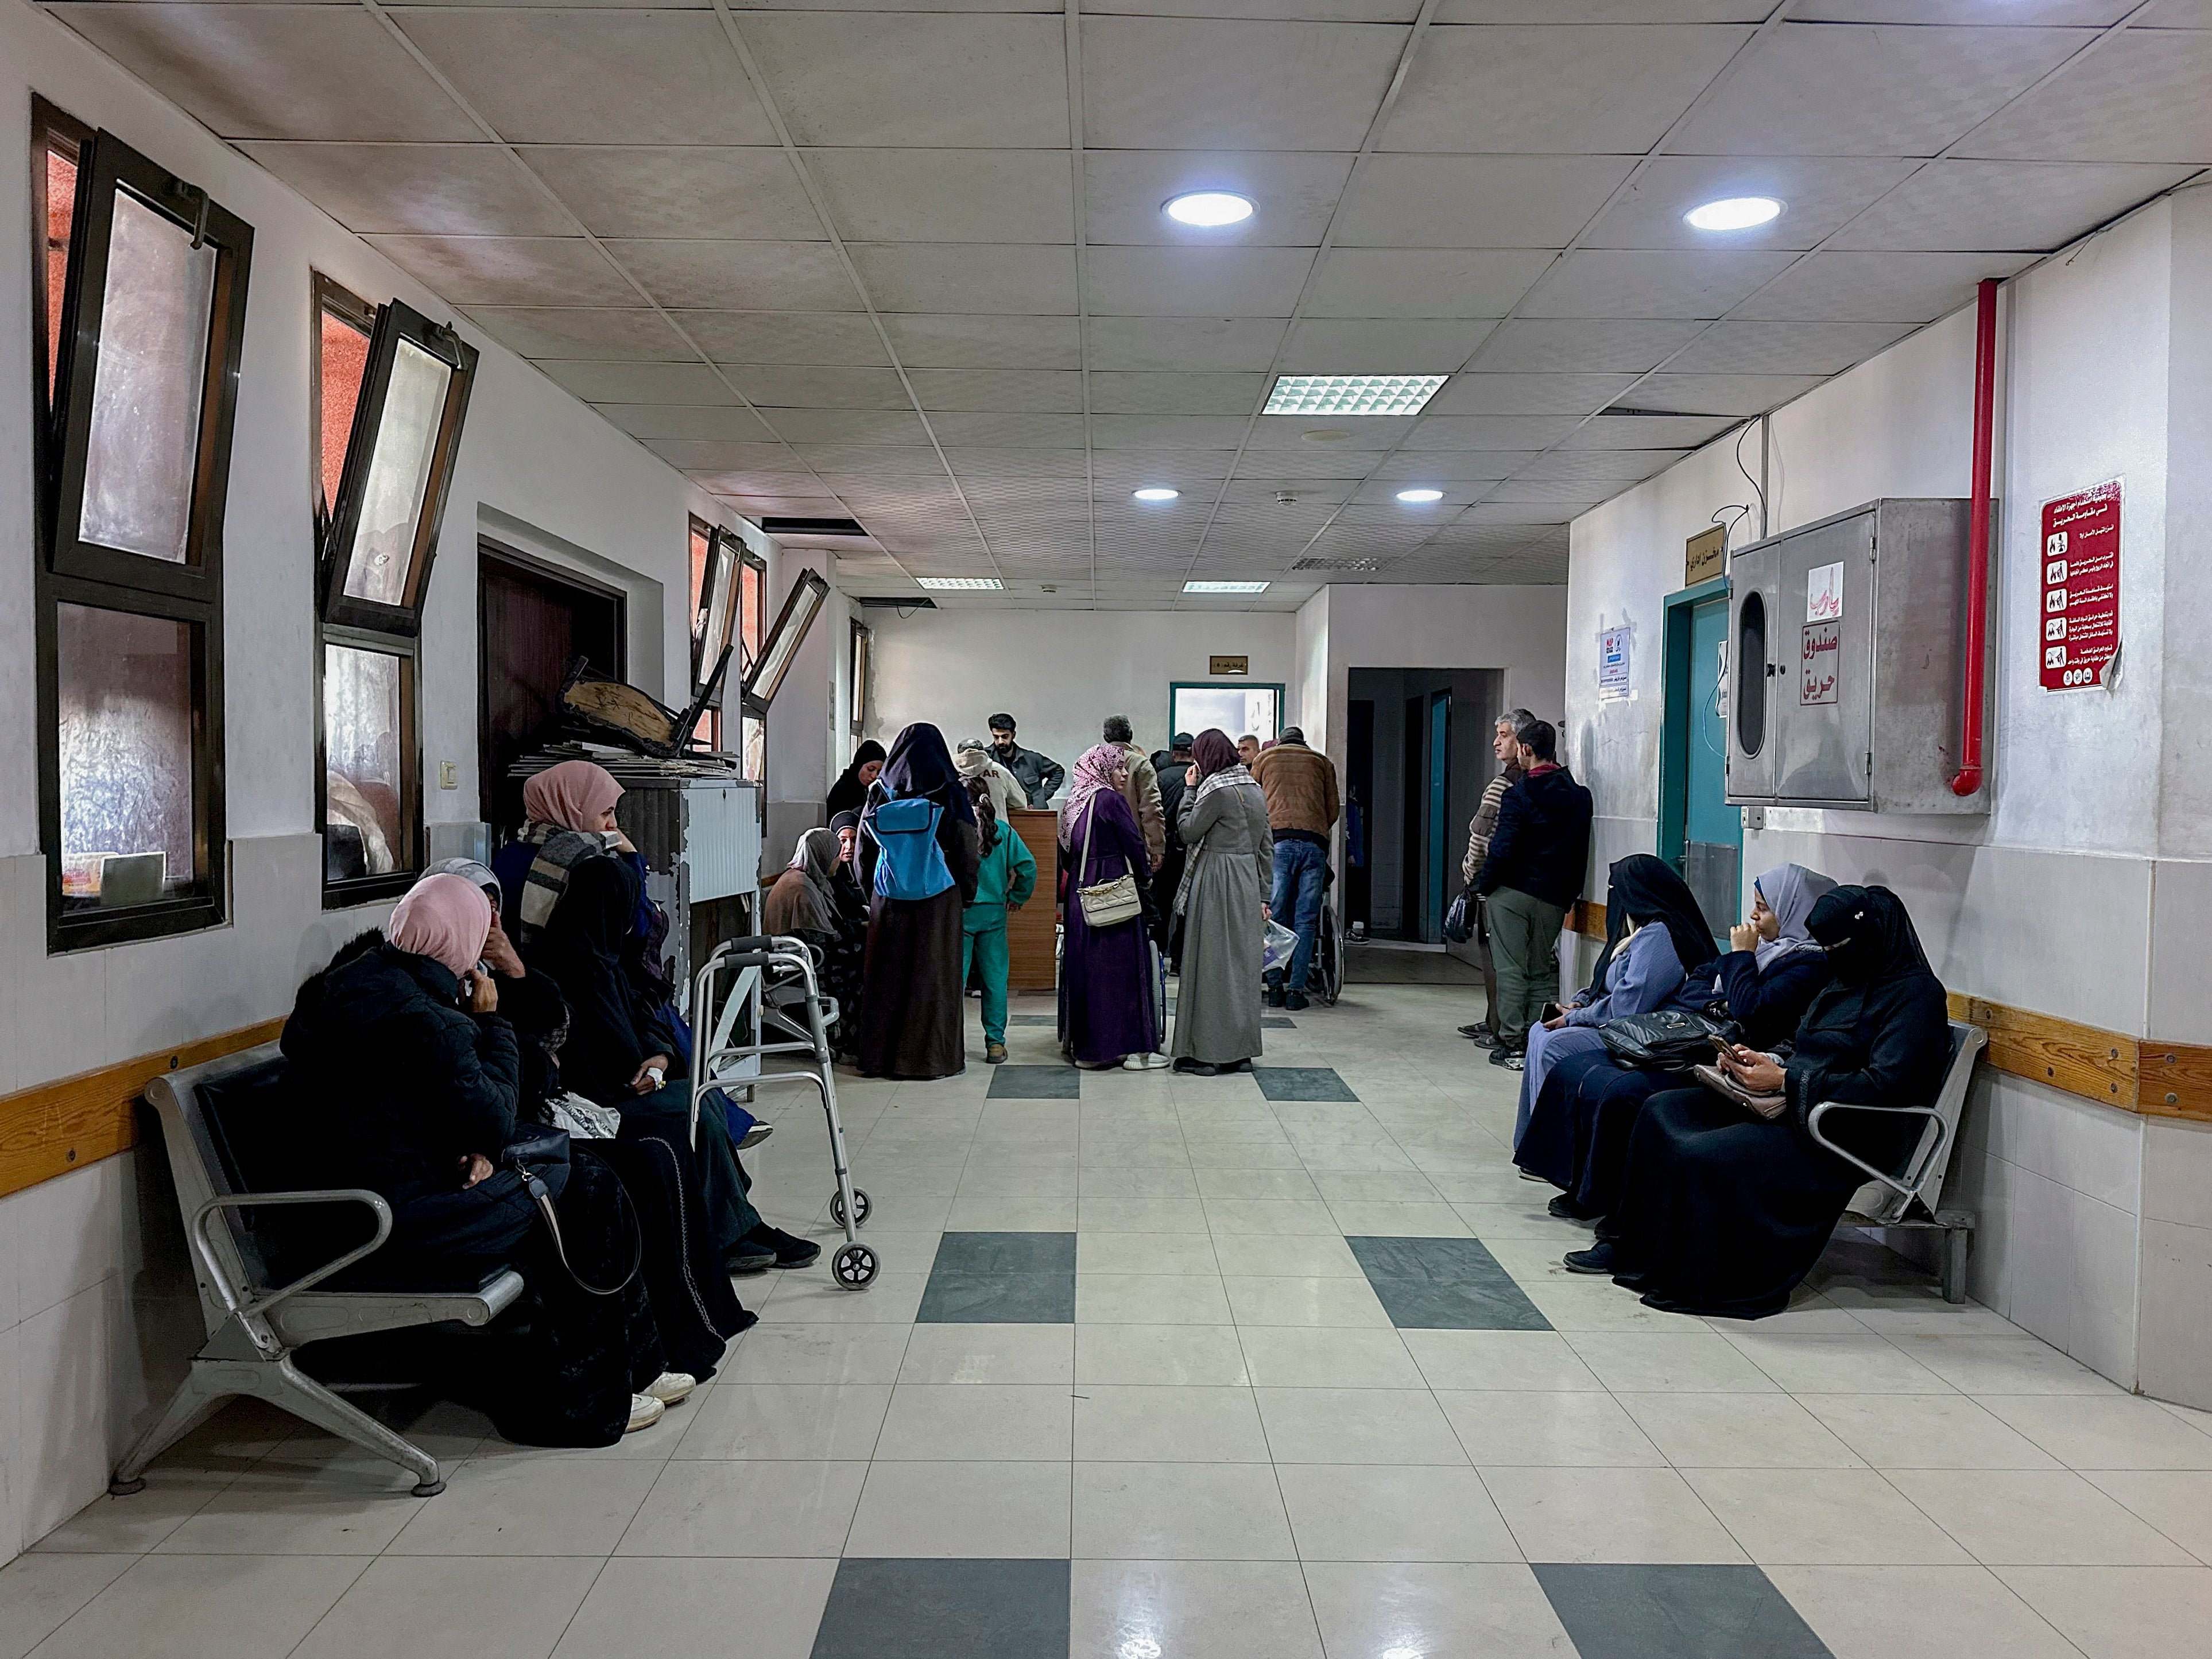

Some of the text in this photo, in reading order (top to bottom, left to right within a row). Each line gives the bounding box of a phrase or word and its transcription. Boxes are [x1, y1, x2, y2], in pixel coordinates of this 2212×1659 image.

[2053, 514, 2075, 528] الحريق
[2076, 507, 2095, 519] مقاومة
[1804, 627, 1837, 659] صندوق
[1804, 670, 1834, 700] حريق
